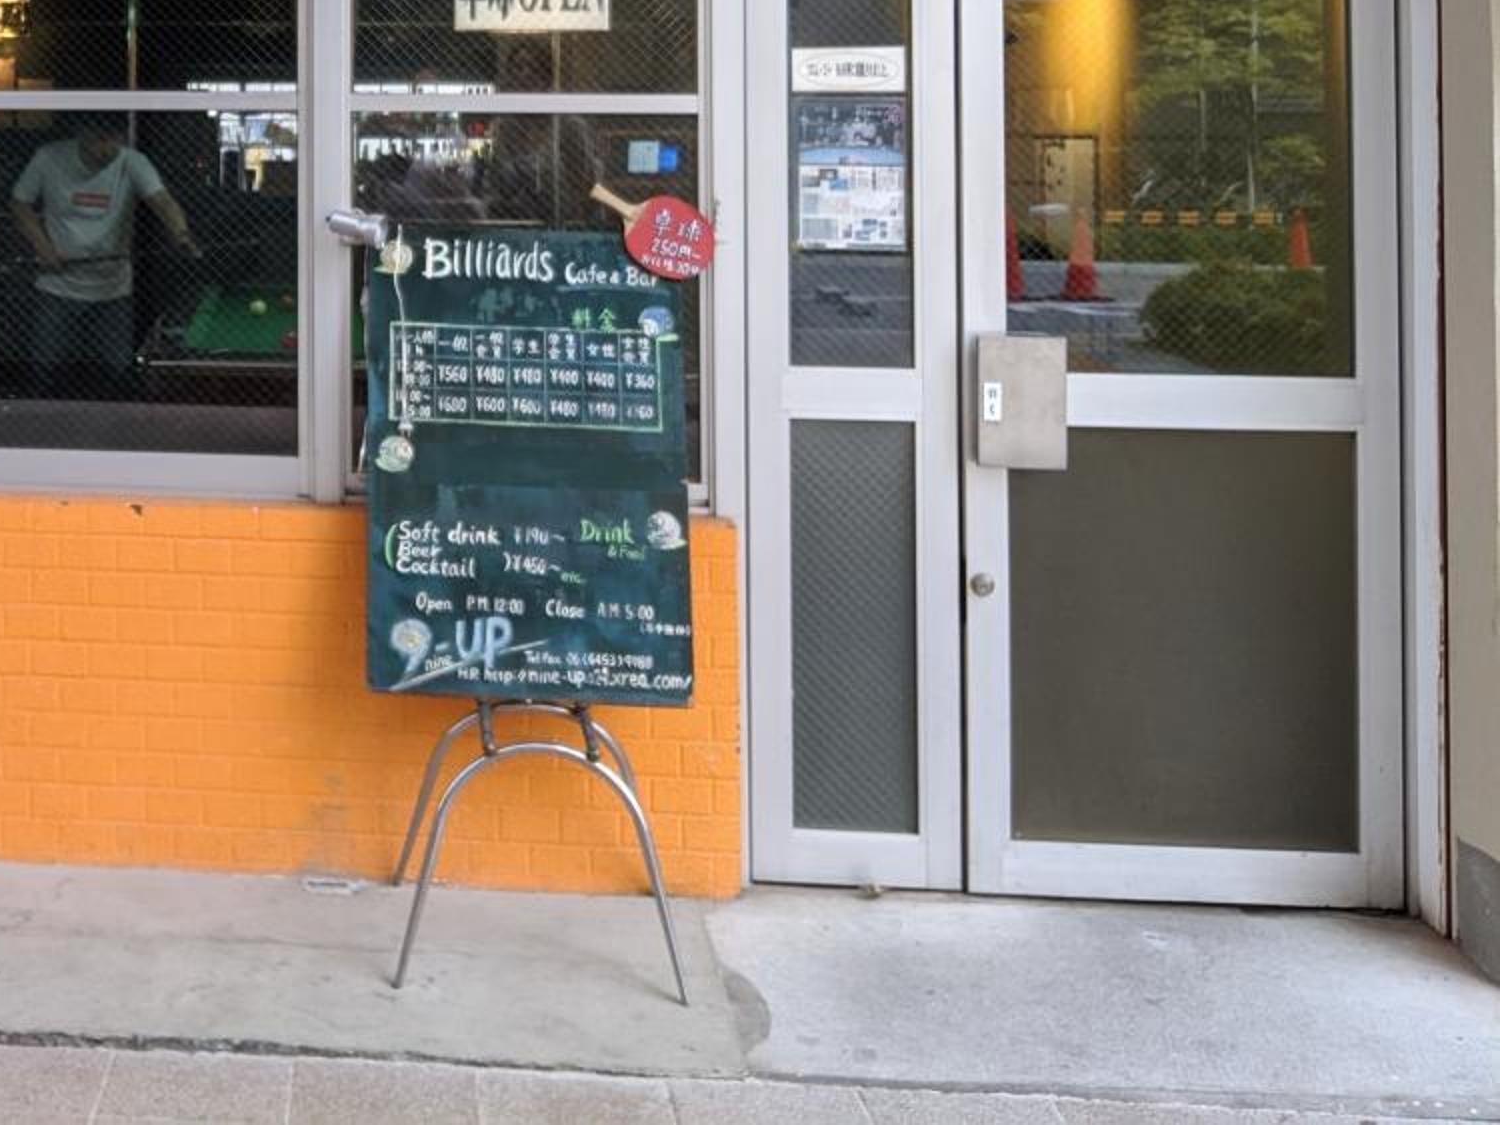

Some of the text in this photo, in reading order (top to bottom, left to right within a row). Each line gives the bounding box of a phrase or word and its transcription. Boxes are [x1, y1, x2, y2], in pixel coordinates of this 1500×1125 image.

[422, 237, 553, 282] Billiards
[564, 262, 607, 285] Cafe
[397, 520, 440, 542] Soft
[448, 522, 501, 545] drink
[580, 519, 634, 543] Drink
[397, 541, 442, 558] Beer
[395, 557, 476, 578] Cocktail
[415, 591, 452, 615] Open
[545, 599, 585, 619] Close
